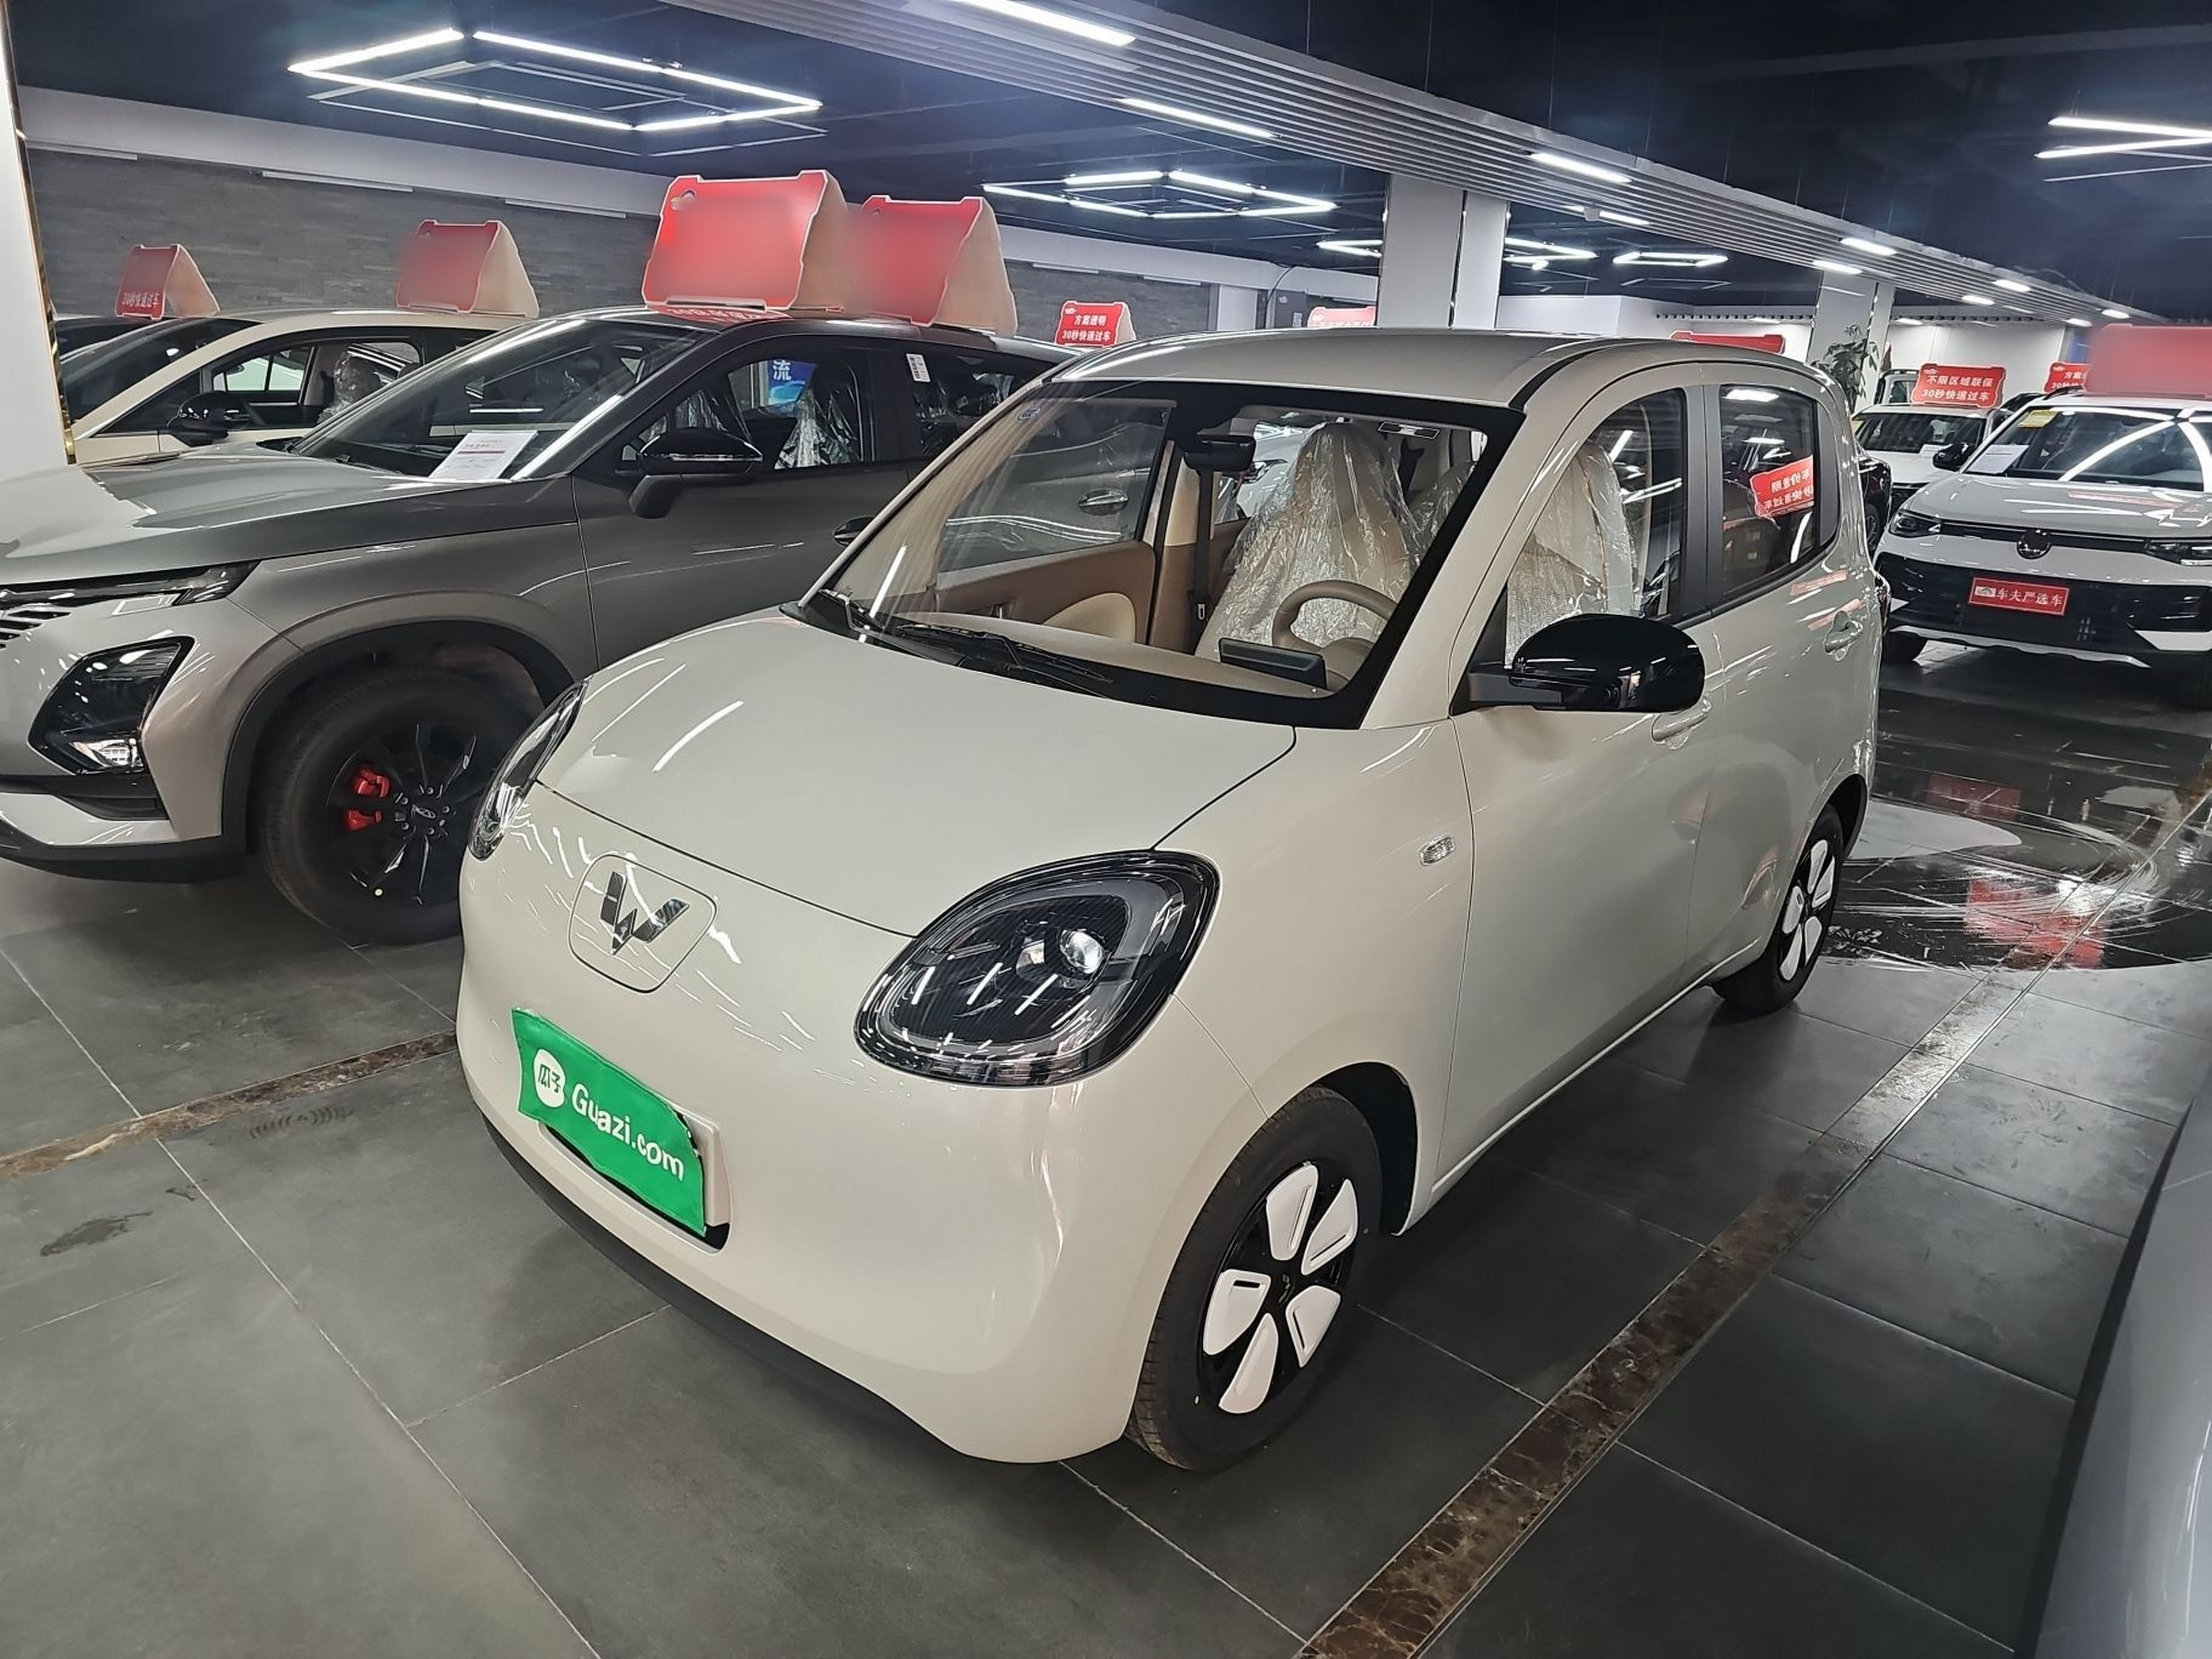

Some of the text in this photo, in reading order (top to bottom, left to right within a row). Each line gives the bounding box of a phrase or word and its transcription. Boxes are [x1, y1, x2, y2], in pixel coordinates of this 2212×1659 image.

[1074, 315, 1107, 325] 方案透明
[772, 359, 792, 380] 流
[1927, 375, 1993, 387] 不限区域联保
[1922, 389, 1990, 402] 30秒快速过车
[1996, 588, 2063, 607] 车夫严选车
[537, 1063, 684, 1181] 瓜子 Guazi.com
